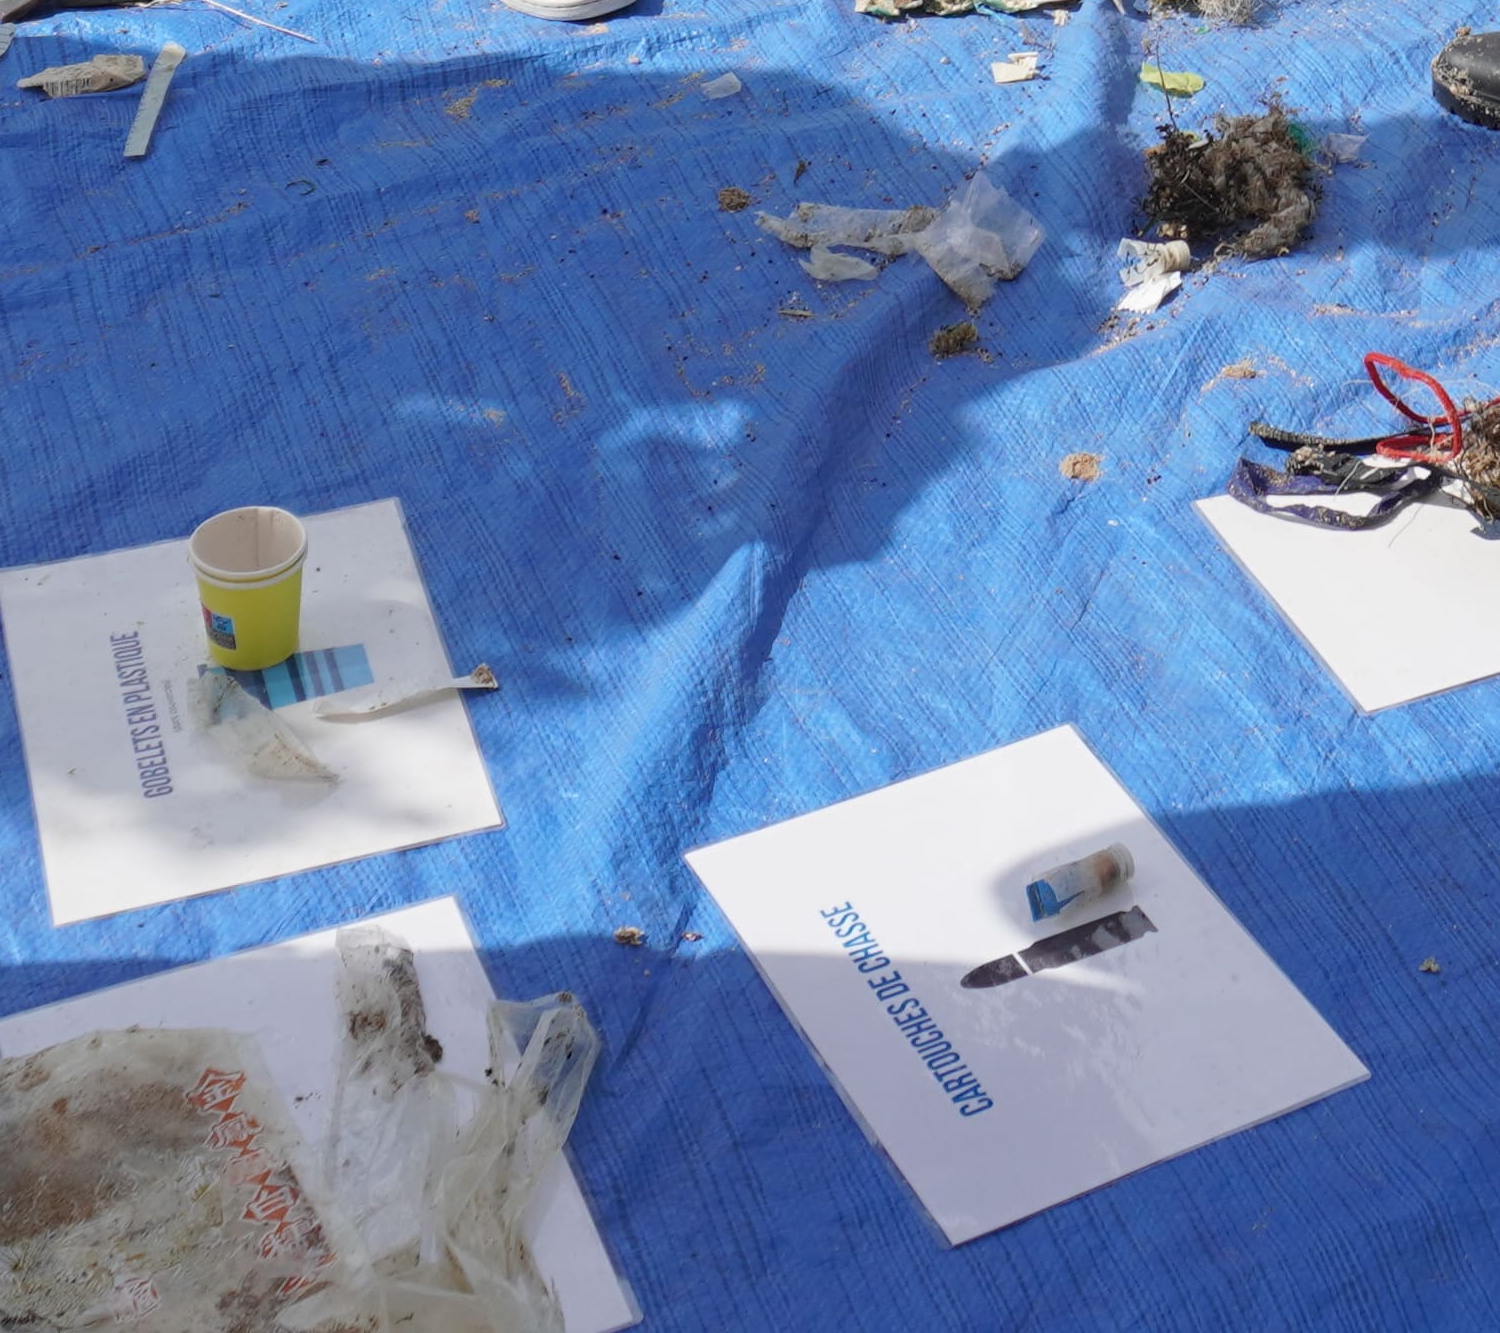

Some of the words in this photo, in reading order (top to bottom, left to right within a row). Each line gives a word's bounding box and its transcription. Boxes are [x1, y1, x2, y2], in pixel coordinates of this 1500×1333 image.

[110, 631, 153, 704] PLASTIQUE
[126, 703, 157, 726] EN
[130, 725, 173, 799] GOBELETS
[820, 901, 890, 973] CHASSE
[867, 971, 910, 1001] DE
[887, 998, 994, 1117] CARTOUCHES
